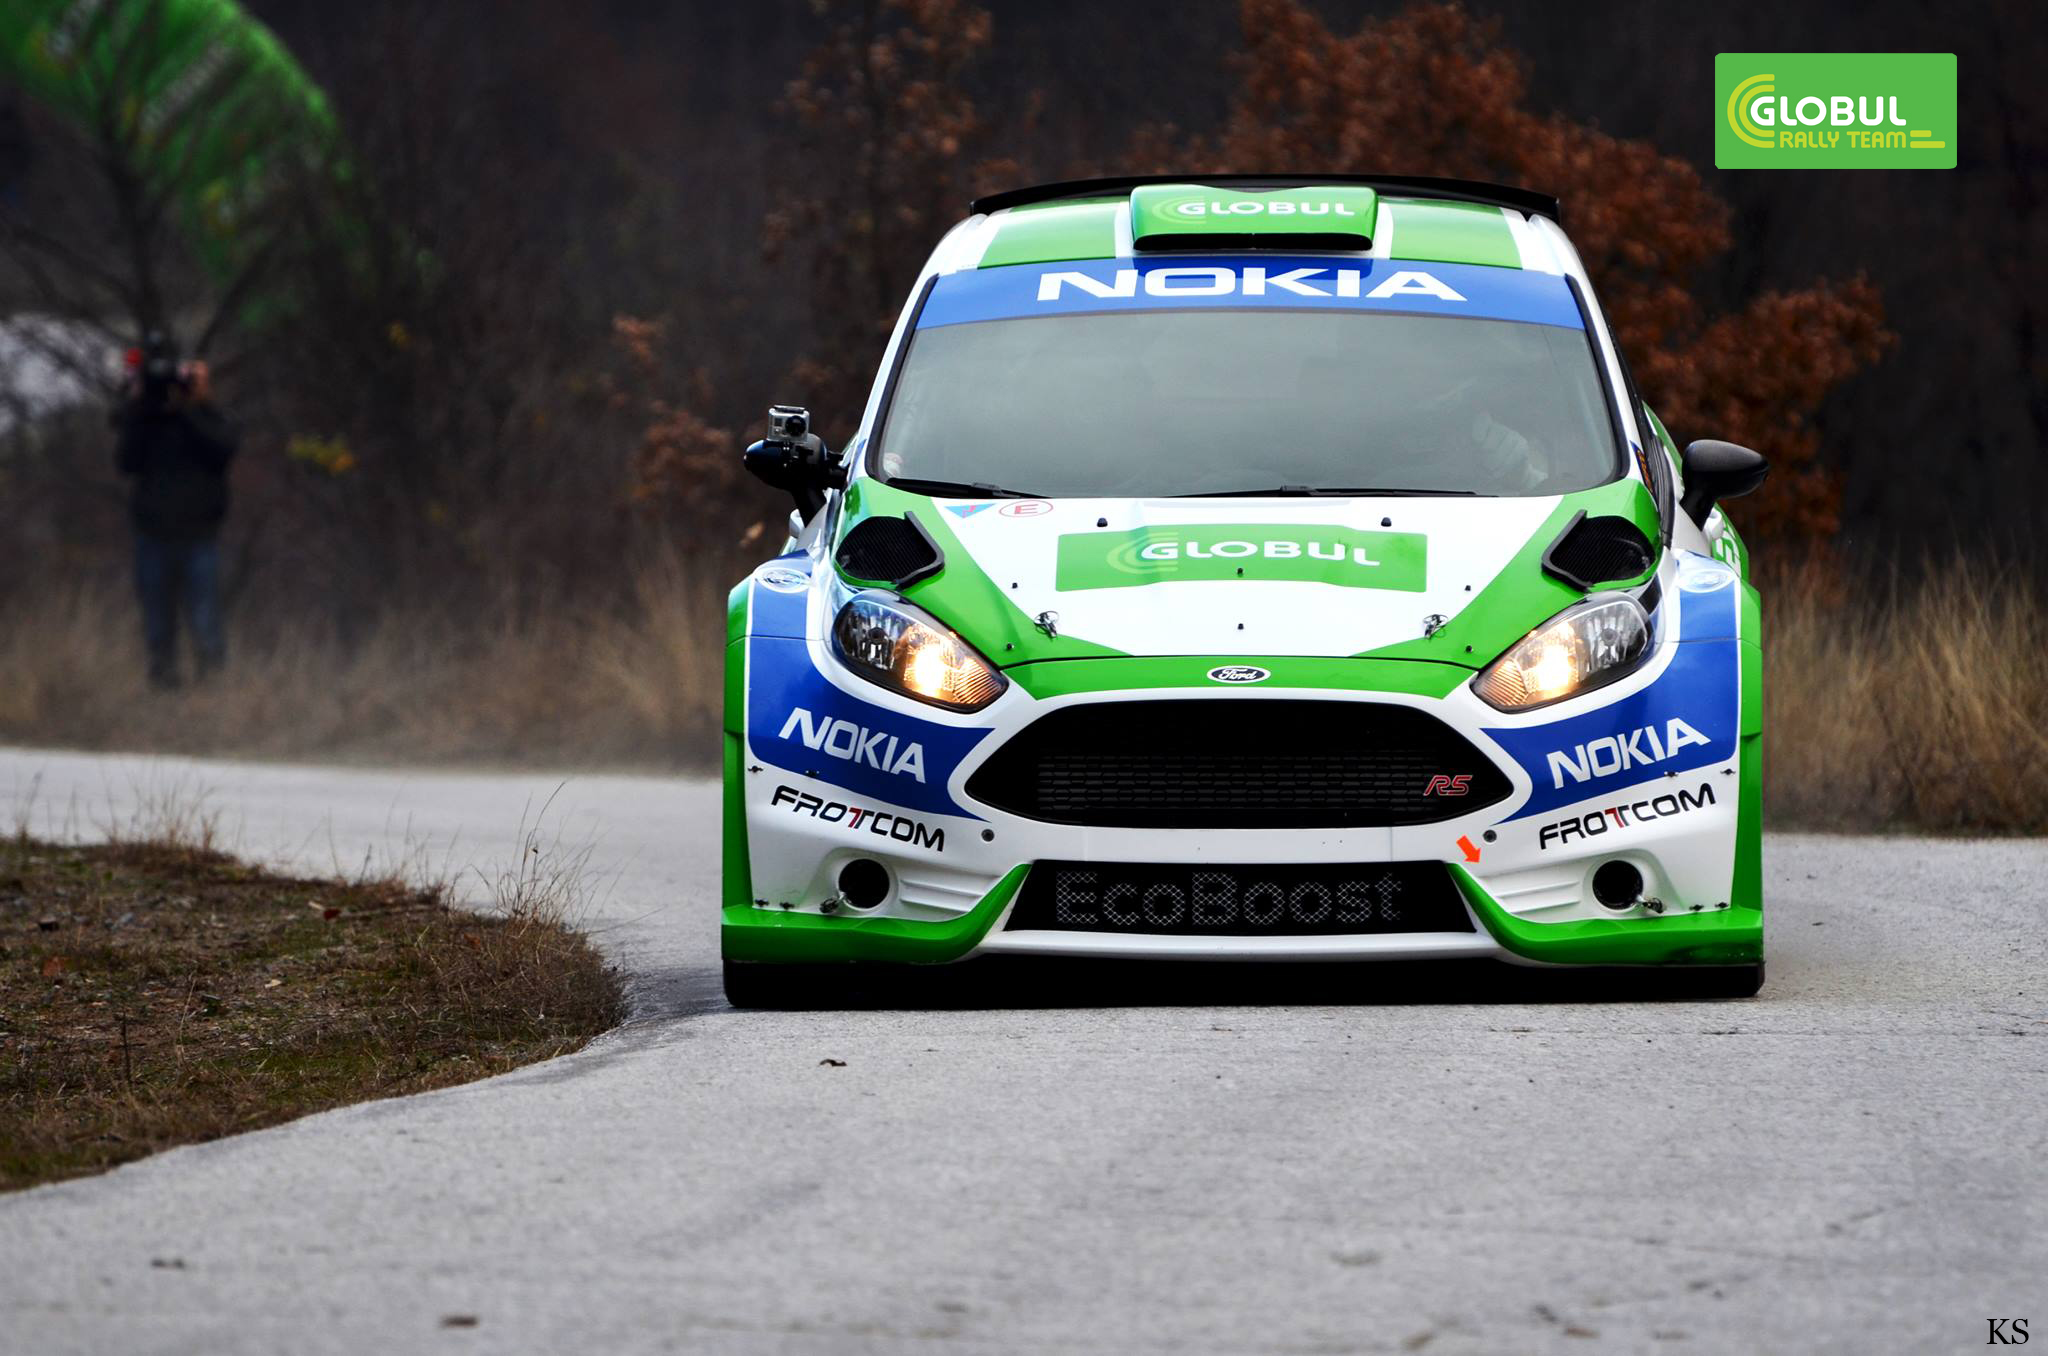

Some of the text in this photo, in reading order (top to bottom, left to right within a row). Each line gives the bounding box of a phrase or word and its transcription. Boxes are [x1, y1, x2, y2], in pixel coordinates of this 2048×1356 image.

[1177, 200, 1356, 217] GLOBUL
[1036, 266, 1468, 302] NOKIA
[1141, 540, 1381, 567] GLOBUL
[1218, 667, 1257, 680] Ford
[778, 706, 926, 784] NOKIA
[1546, 717, 1712, 790] NOKIA
[1423, 774, 1473, 797] RS
[1055, 870, 1403, 927] EcoBoost
